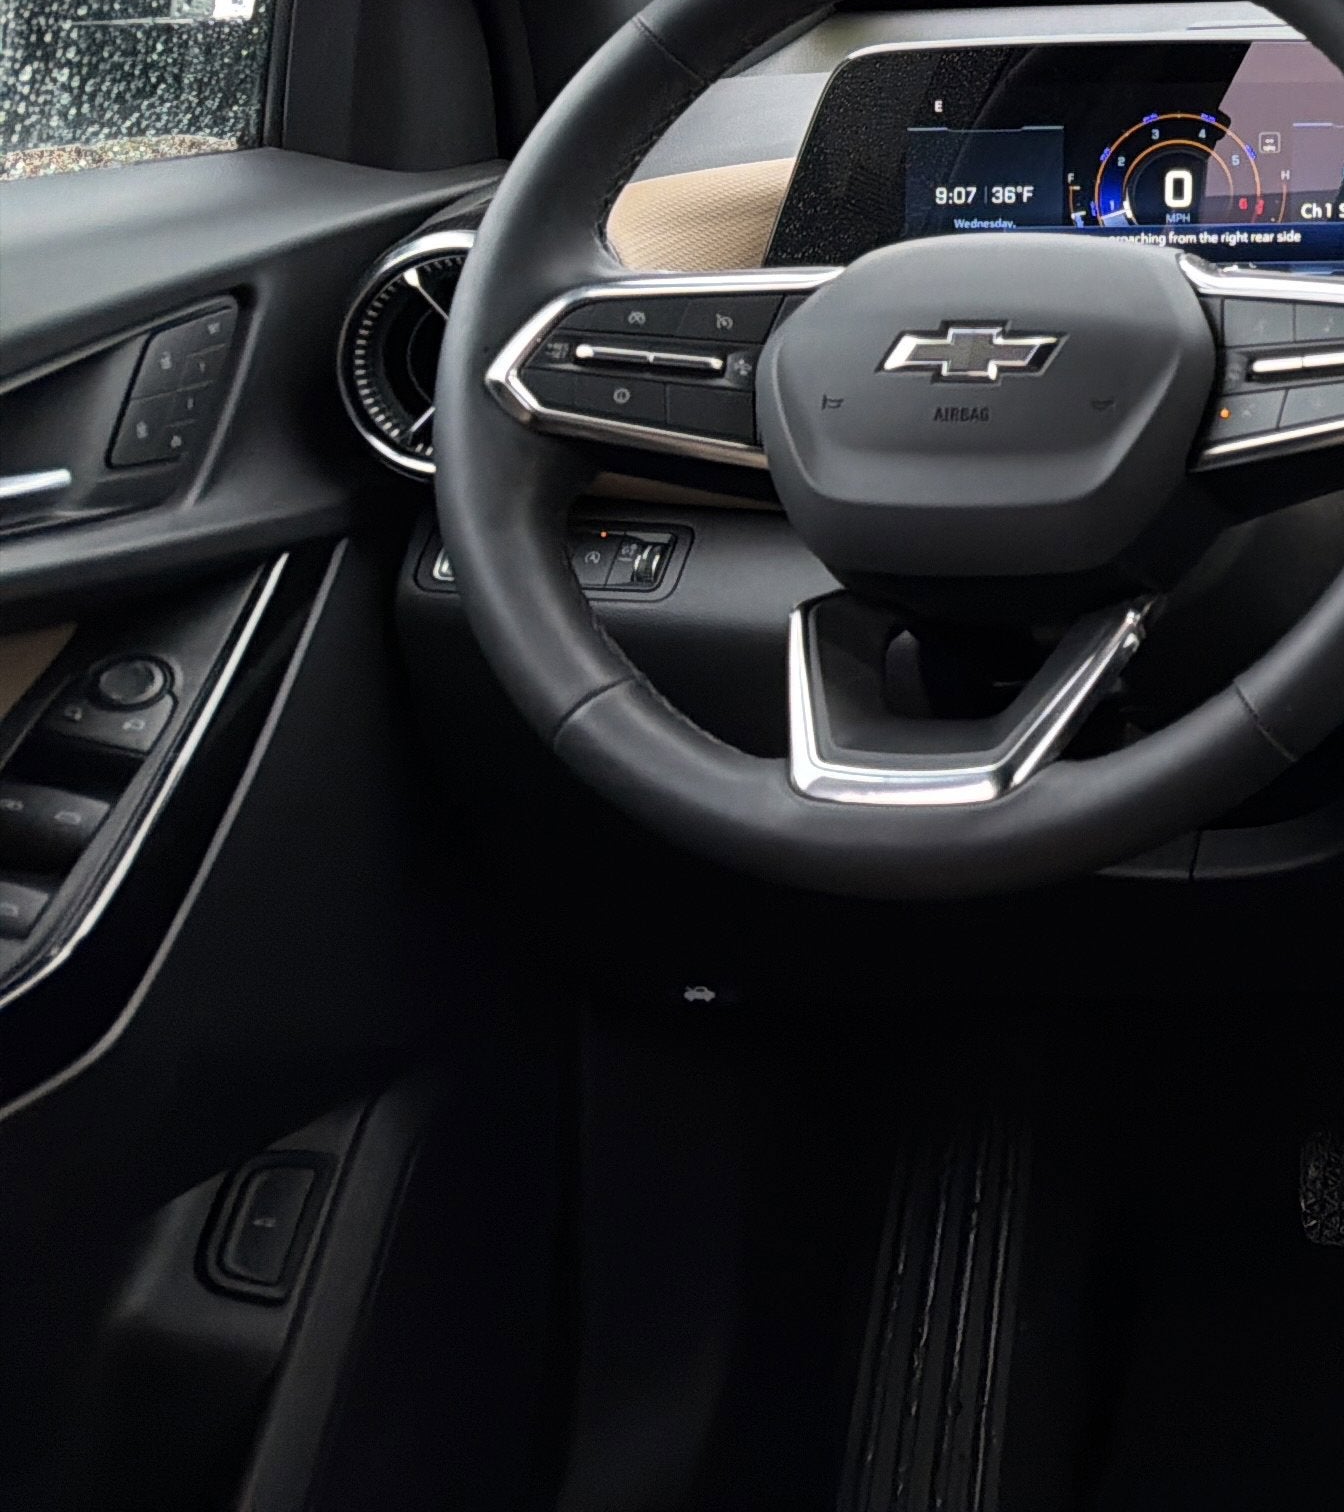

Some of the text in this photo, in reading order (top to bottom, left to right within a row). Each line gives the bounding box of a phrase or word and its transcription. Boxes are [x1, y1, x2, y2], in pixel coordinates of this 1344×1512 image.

[1151, 128, 1160, 140] 3
[1197, 128, 1207, 139] 4
[1116, 156, 1126, 167] 2
[935, 185, 1035, 205] 9:07 36°F
[1163, 169, 1194, 208] 0
[1165, 212, 1191, 224] MPH
[1300, 203, 1322, 219] Ch
[1325, 202, 1333, 218] 1
[1169, 231, 1198, 244] from
[1199, 230, 1218, 244] the
[1220, 230, 1249, 247] right
[1251, 232, 1274, 243] rear
[1277, 229, 1302, 243] side
[933, 406, 990, 423] AIRBAG
